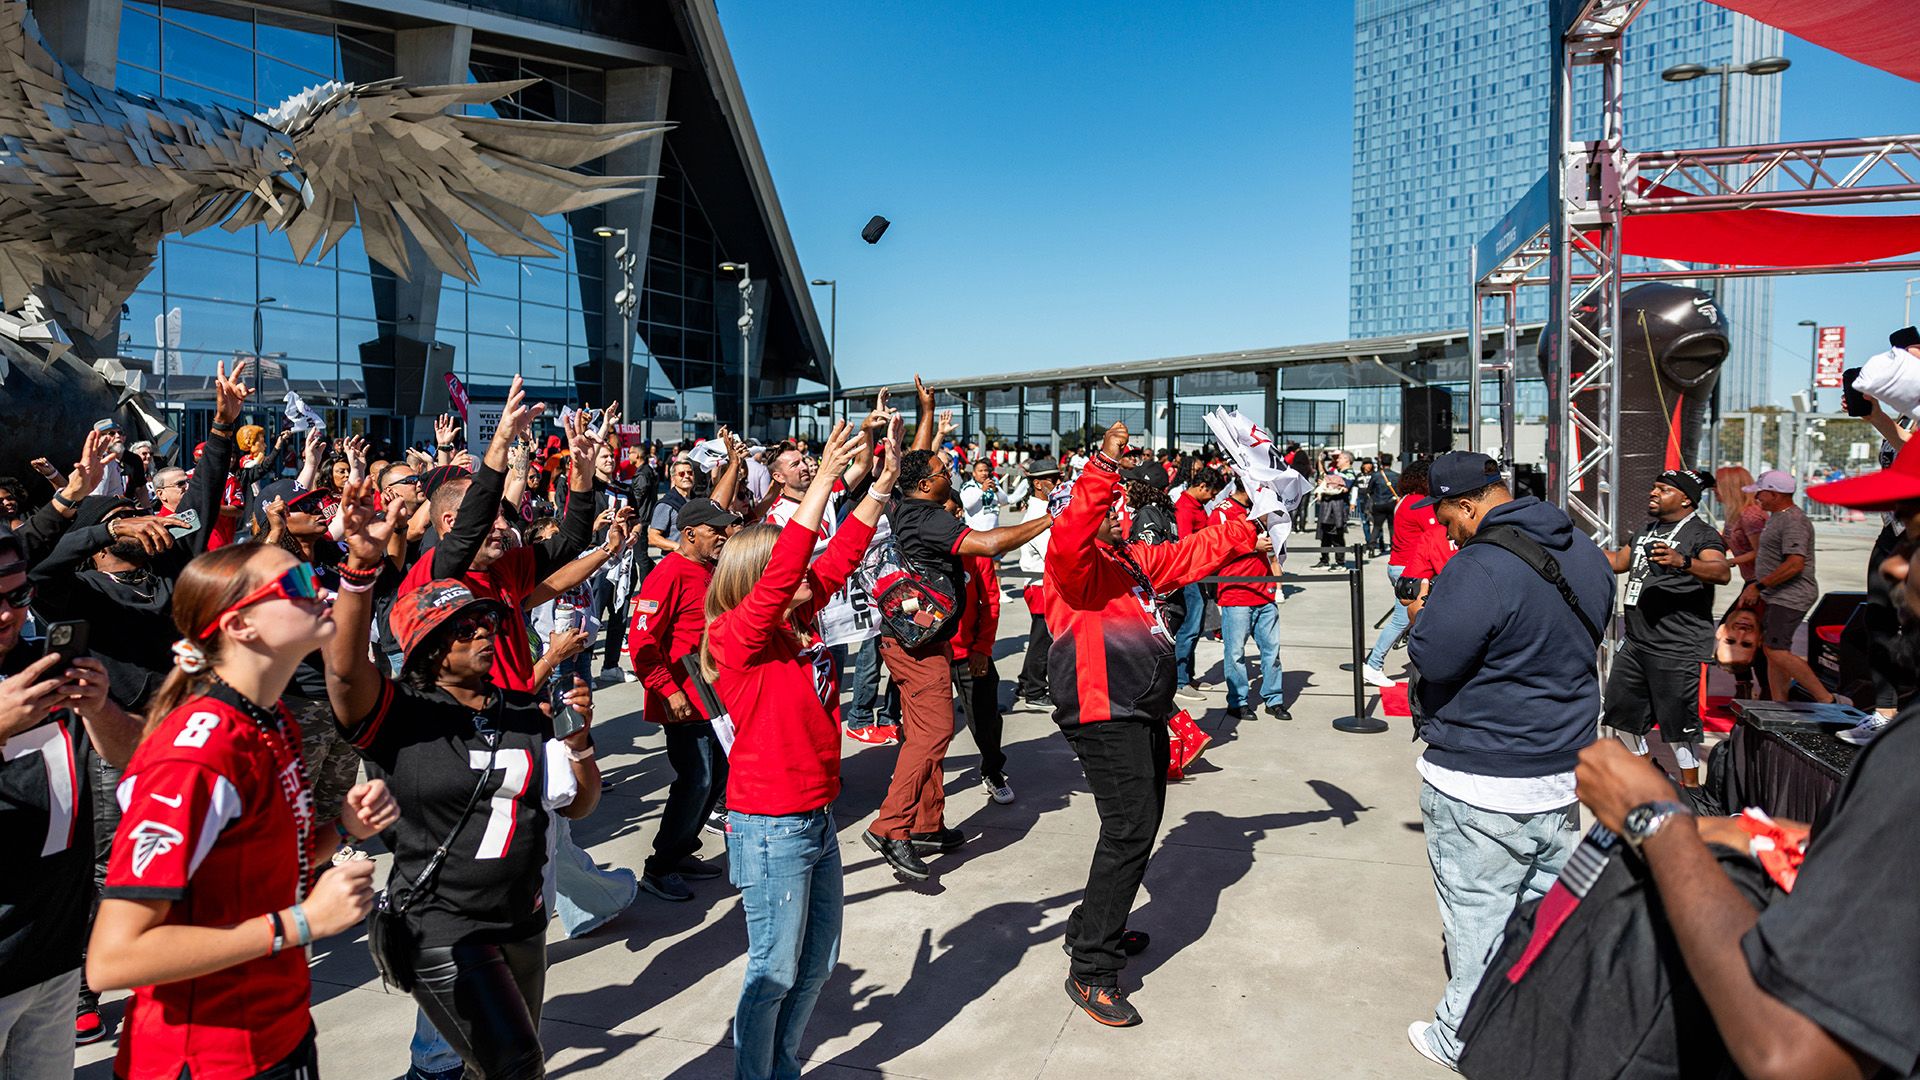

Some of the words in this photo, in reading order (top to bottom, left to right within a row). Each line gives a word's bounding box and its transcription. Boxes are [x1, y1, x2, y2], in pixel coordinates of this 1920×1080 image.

[432, 589, 472, 608] FALCO
[172, 710, 221, 750] 8
[468, 747, 534, 860] 7
